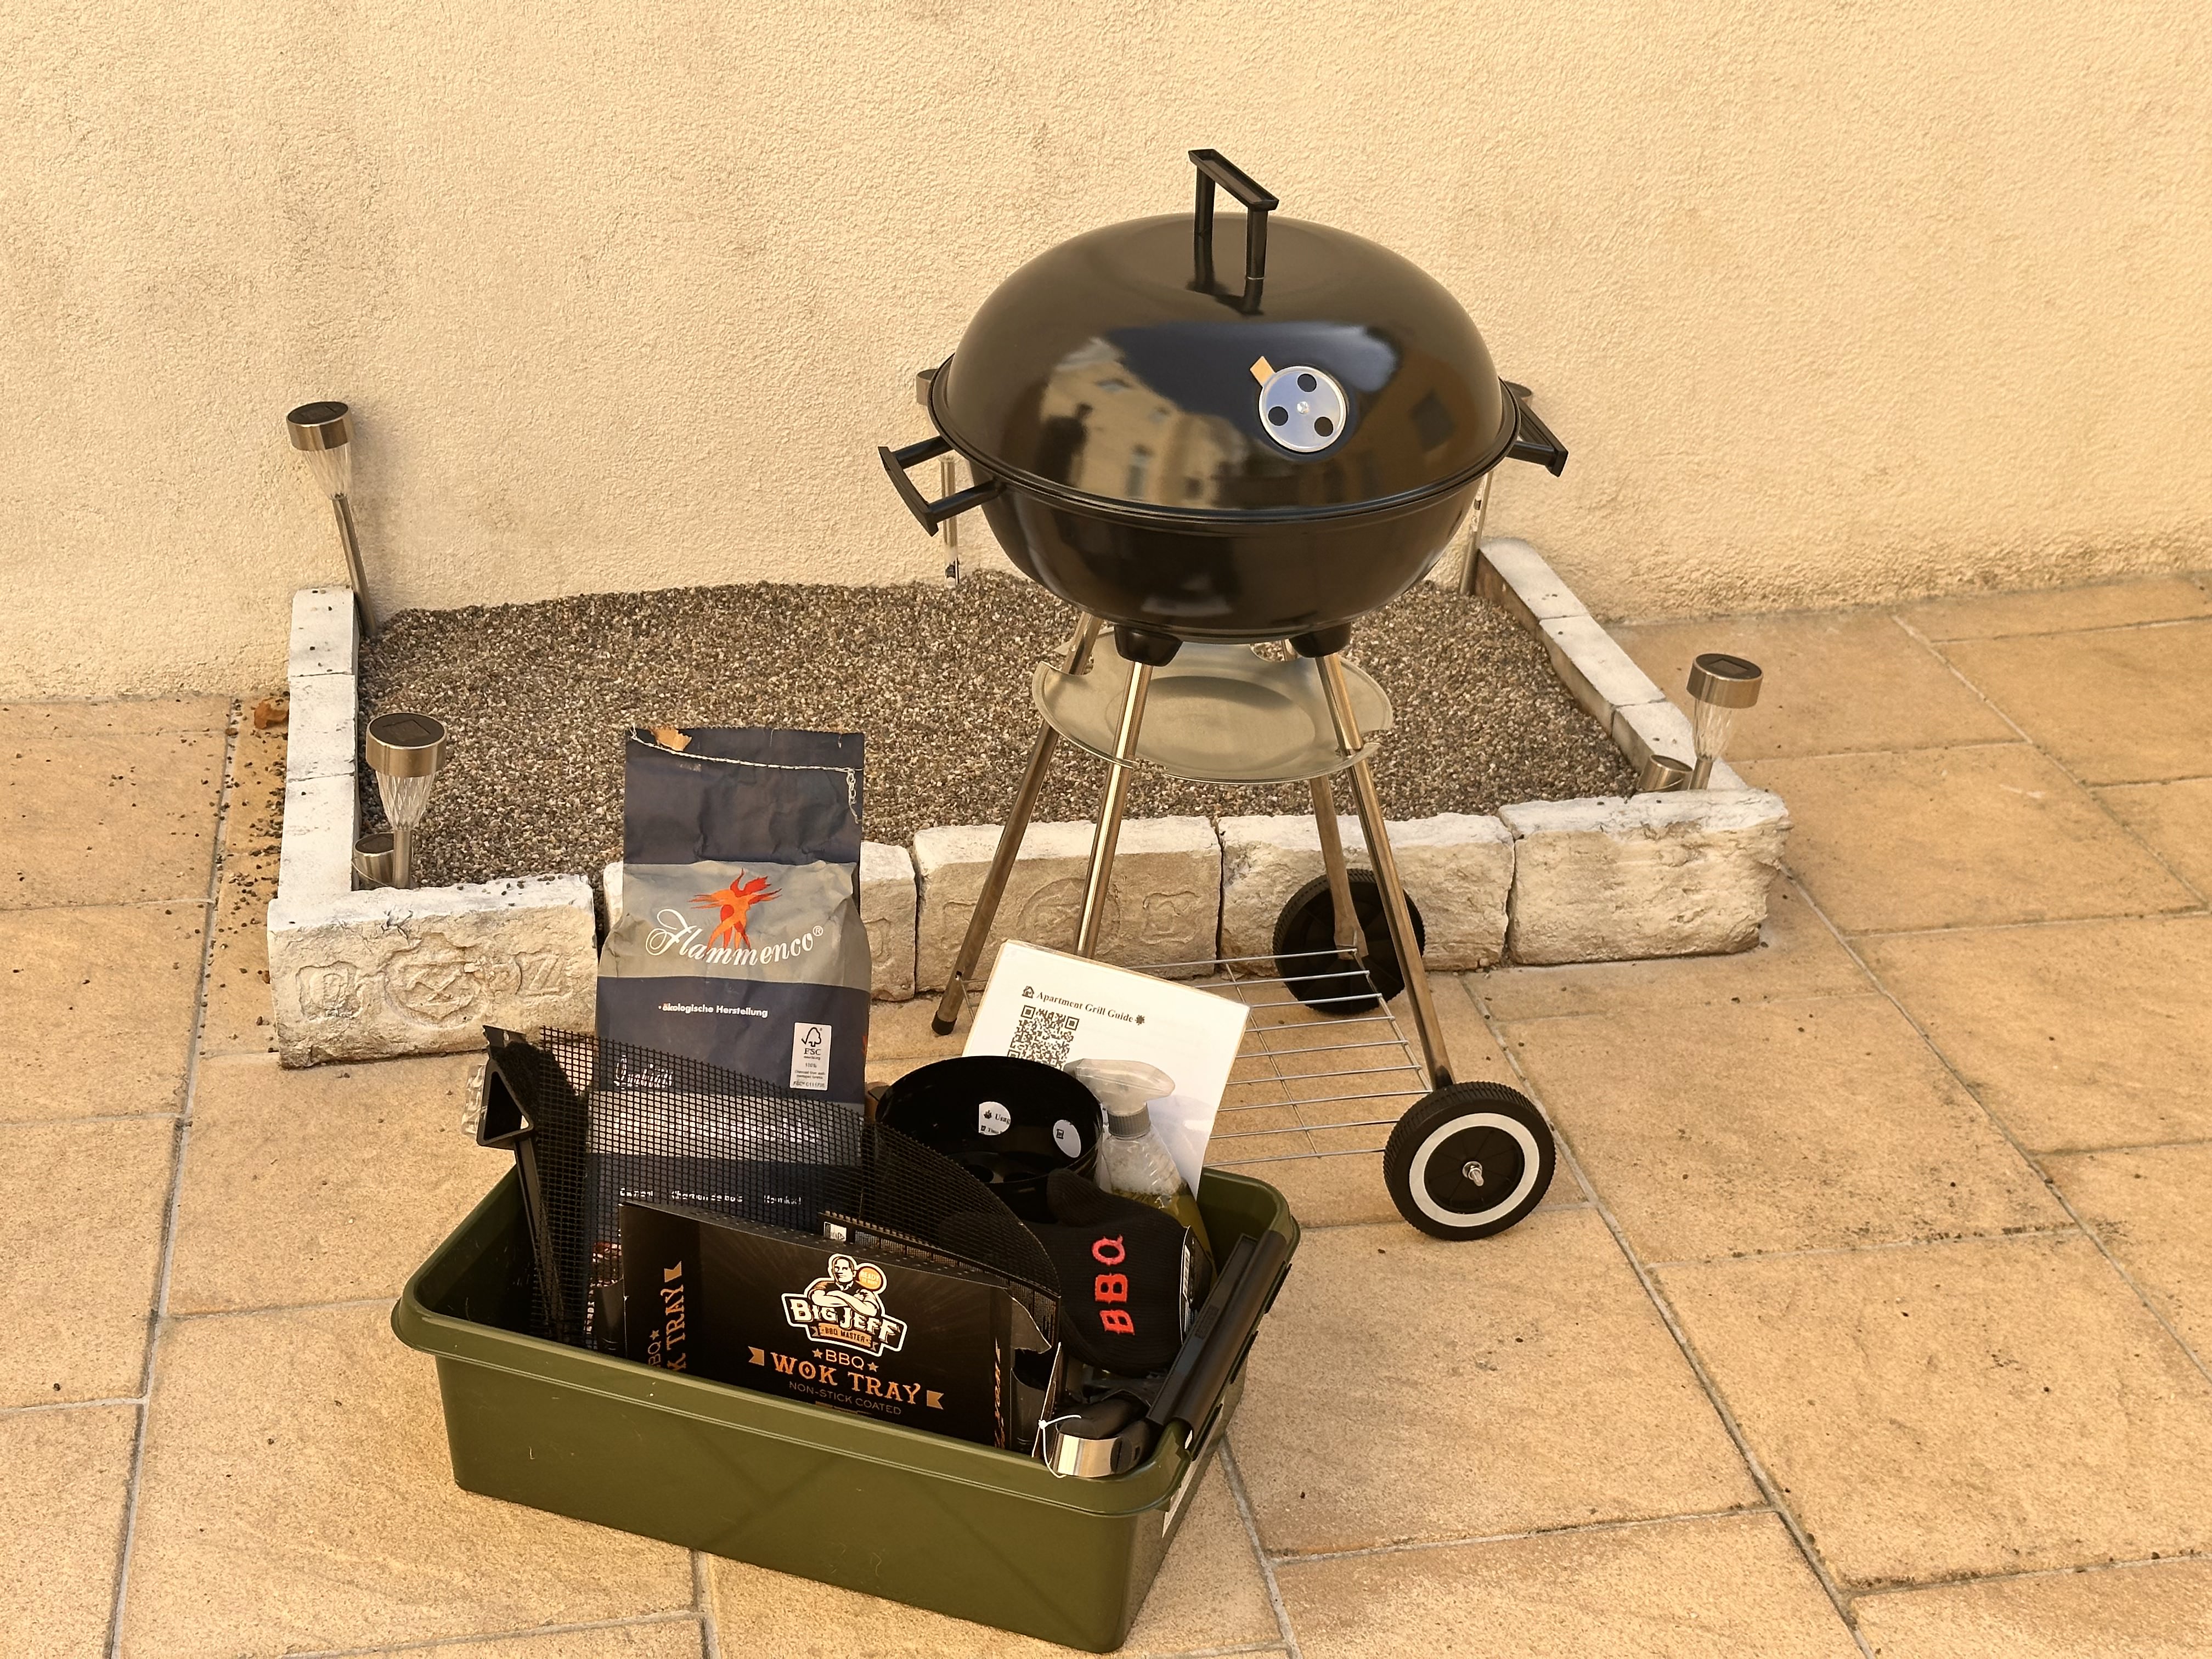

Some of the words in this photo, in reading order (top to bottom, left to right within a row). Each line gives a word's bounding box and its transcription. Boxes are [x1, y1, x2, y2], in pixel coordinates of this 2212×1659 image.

[715, 1005, 768, 1018] Herstellung
[1036, 991, 1083, 1010] Apartment
[1085, 1003, 1106, 1016] Grill
[1108, 1009, 1134, 1023] Guide
[803, 1047, 822, 1056] FSC
[1092, 1234, 1135, 1336] BBQ
[660, 1284, 686, 1351] TRAY
[789, 1298, 838, 1323] BIG
[839, 1307, 901, 1344] JEFF
[825, 1327, 839, 1336] BBQ
[840, 1329, 865, 1343] MASTER
[825, 1349, 864, 1370] BBQ
[770, 1352, 838, 1386] WOK
[848, 1372, 921, 1405] TRAY
[789, 1381, 853, 1404] NON-STICK
[855, 1397, 902, 1415] COATED
